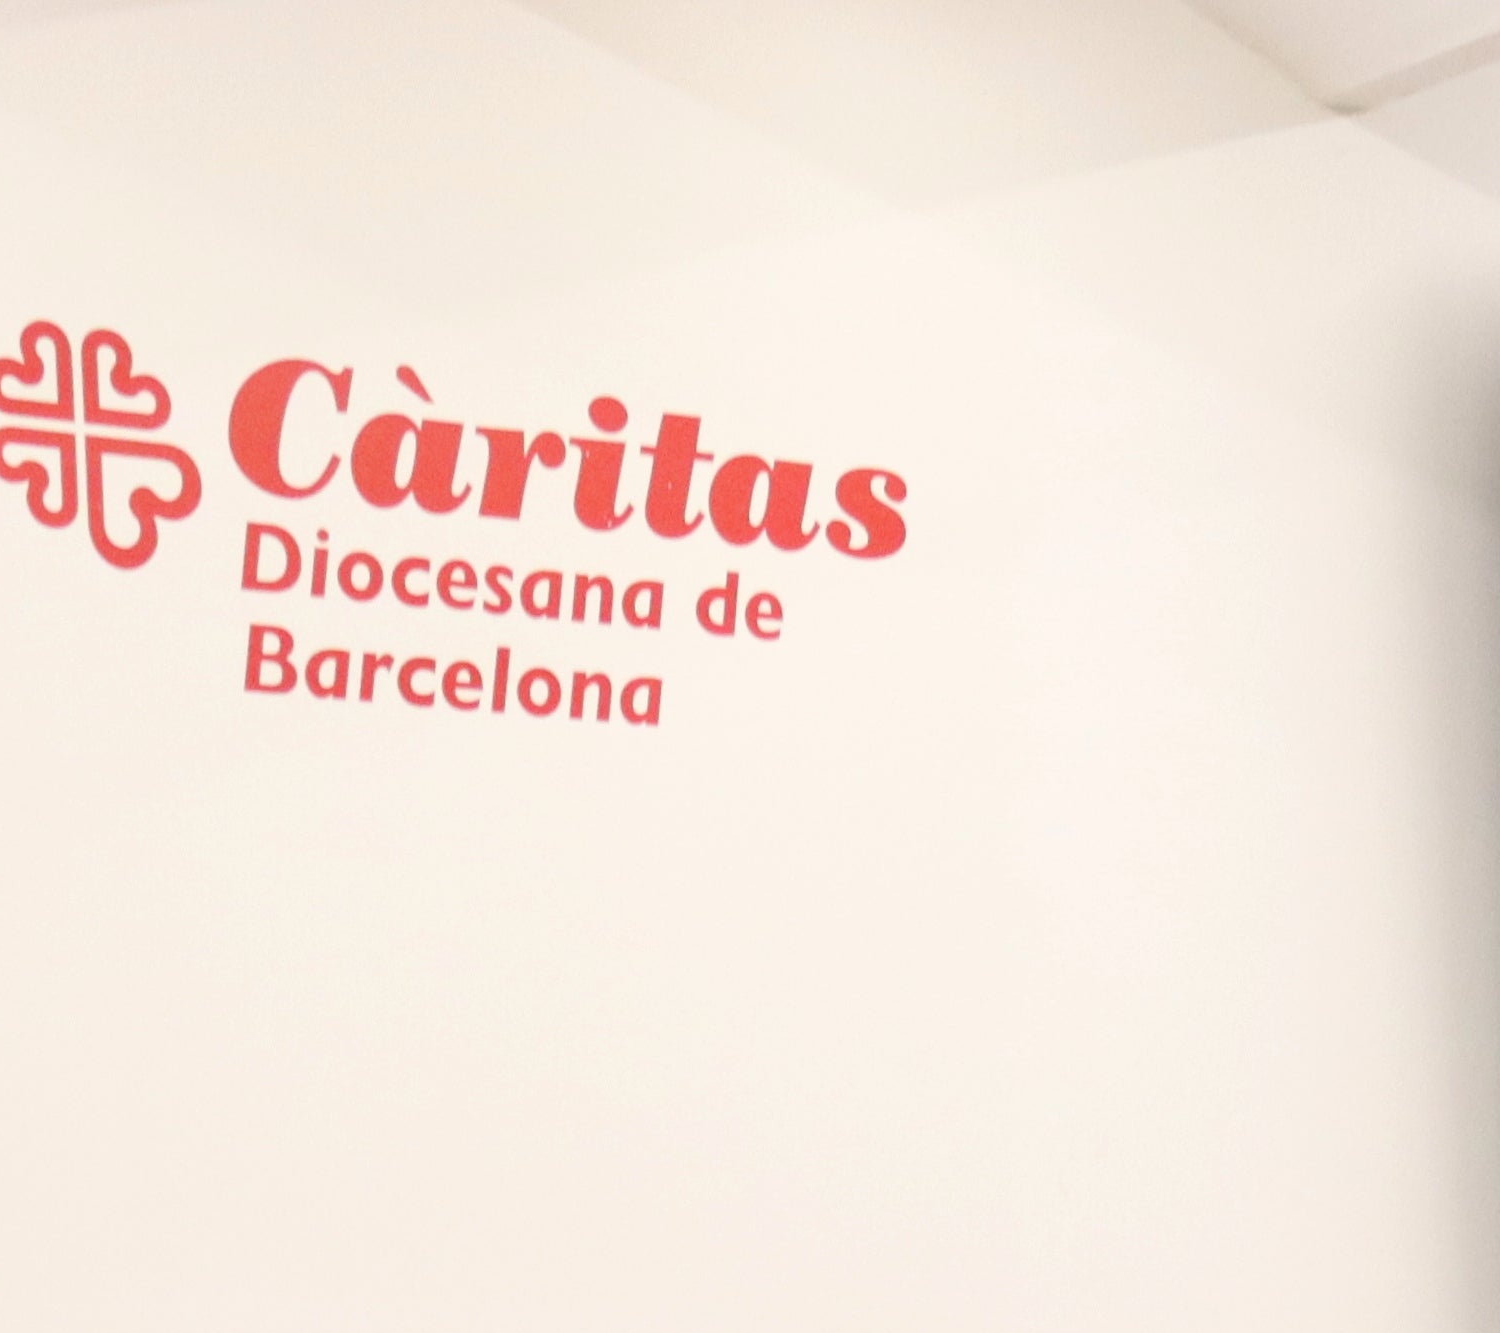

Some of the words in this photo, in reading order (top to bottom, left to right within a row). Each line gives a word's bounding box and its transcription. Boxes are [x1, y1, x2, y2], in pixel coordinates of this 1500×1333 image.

[228, 358, 908, 559] Càritas
[241, 521, 665, 629] Diocesana
[696, 571, 785, 640] de
[244, 624, 663, 727] Barcelona
